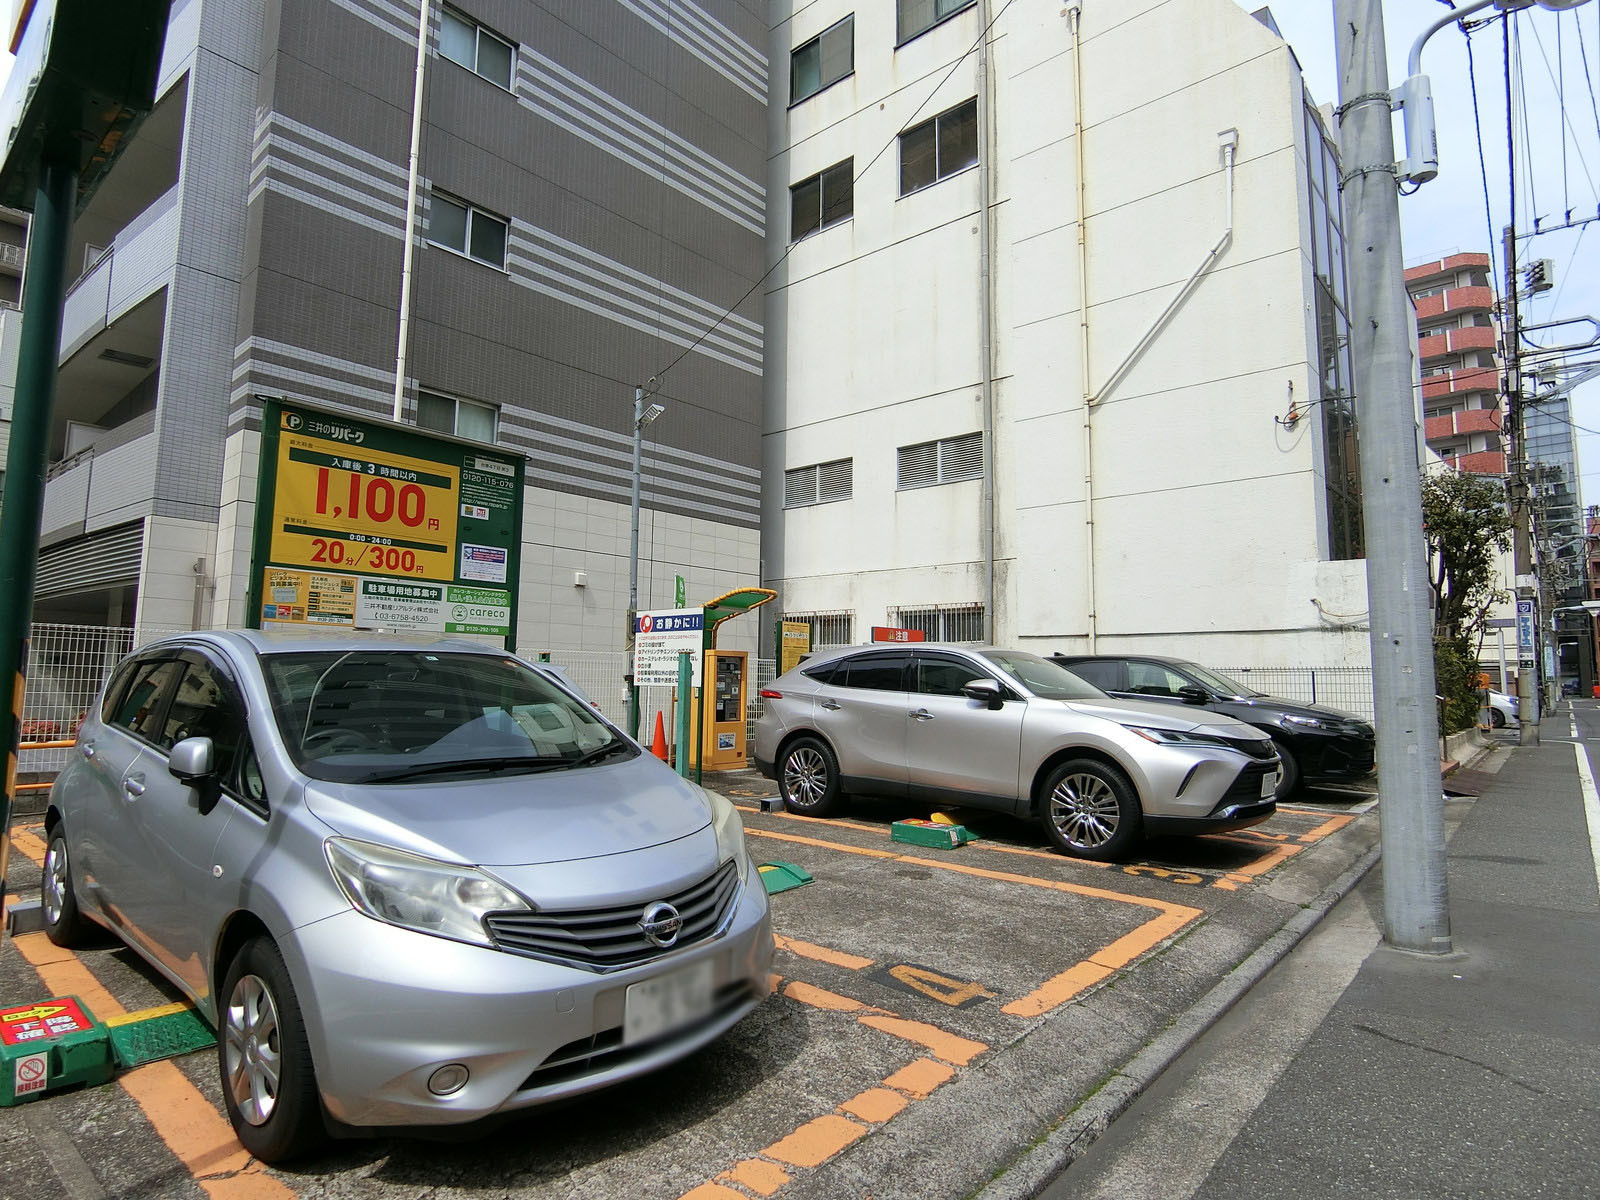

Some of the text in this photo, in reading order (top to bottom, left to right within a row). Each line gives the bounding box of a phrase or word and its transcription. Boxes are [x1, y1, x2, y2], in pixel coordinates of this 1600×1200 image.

[308, 421, 365, 443] 三井のリパーク
[367, 583, 438, 598] 駐車場用地募集中
[363, 603, 439, 614] 三井不動産リアルティ株式会社
[469, 608, 505, 618] careco
[379, 612, 429, 622] 03-6758-4520
[1122, 864, 1204, 885] 3
[889, 963, 1000, 1007] 4
